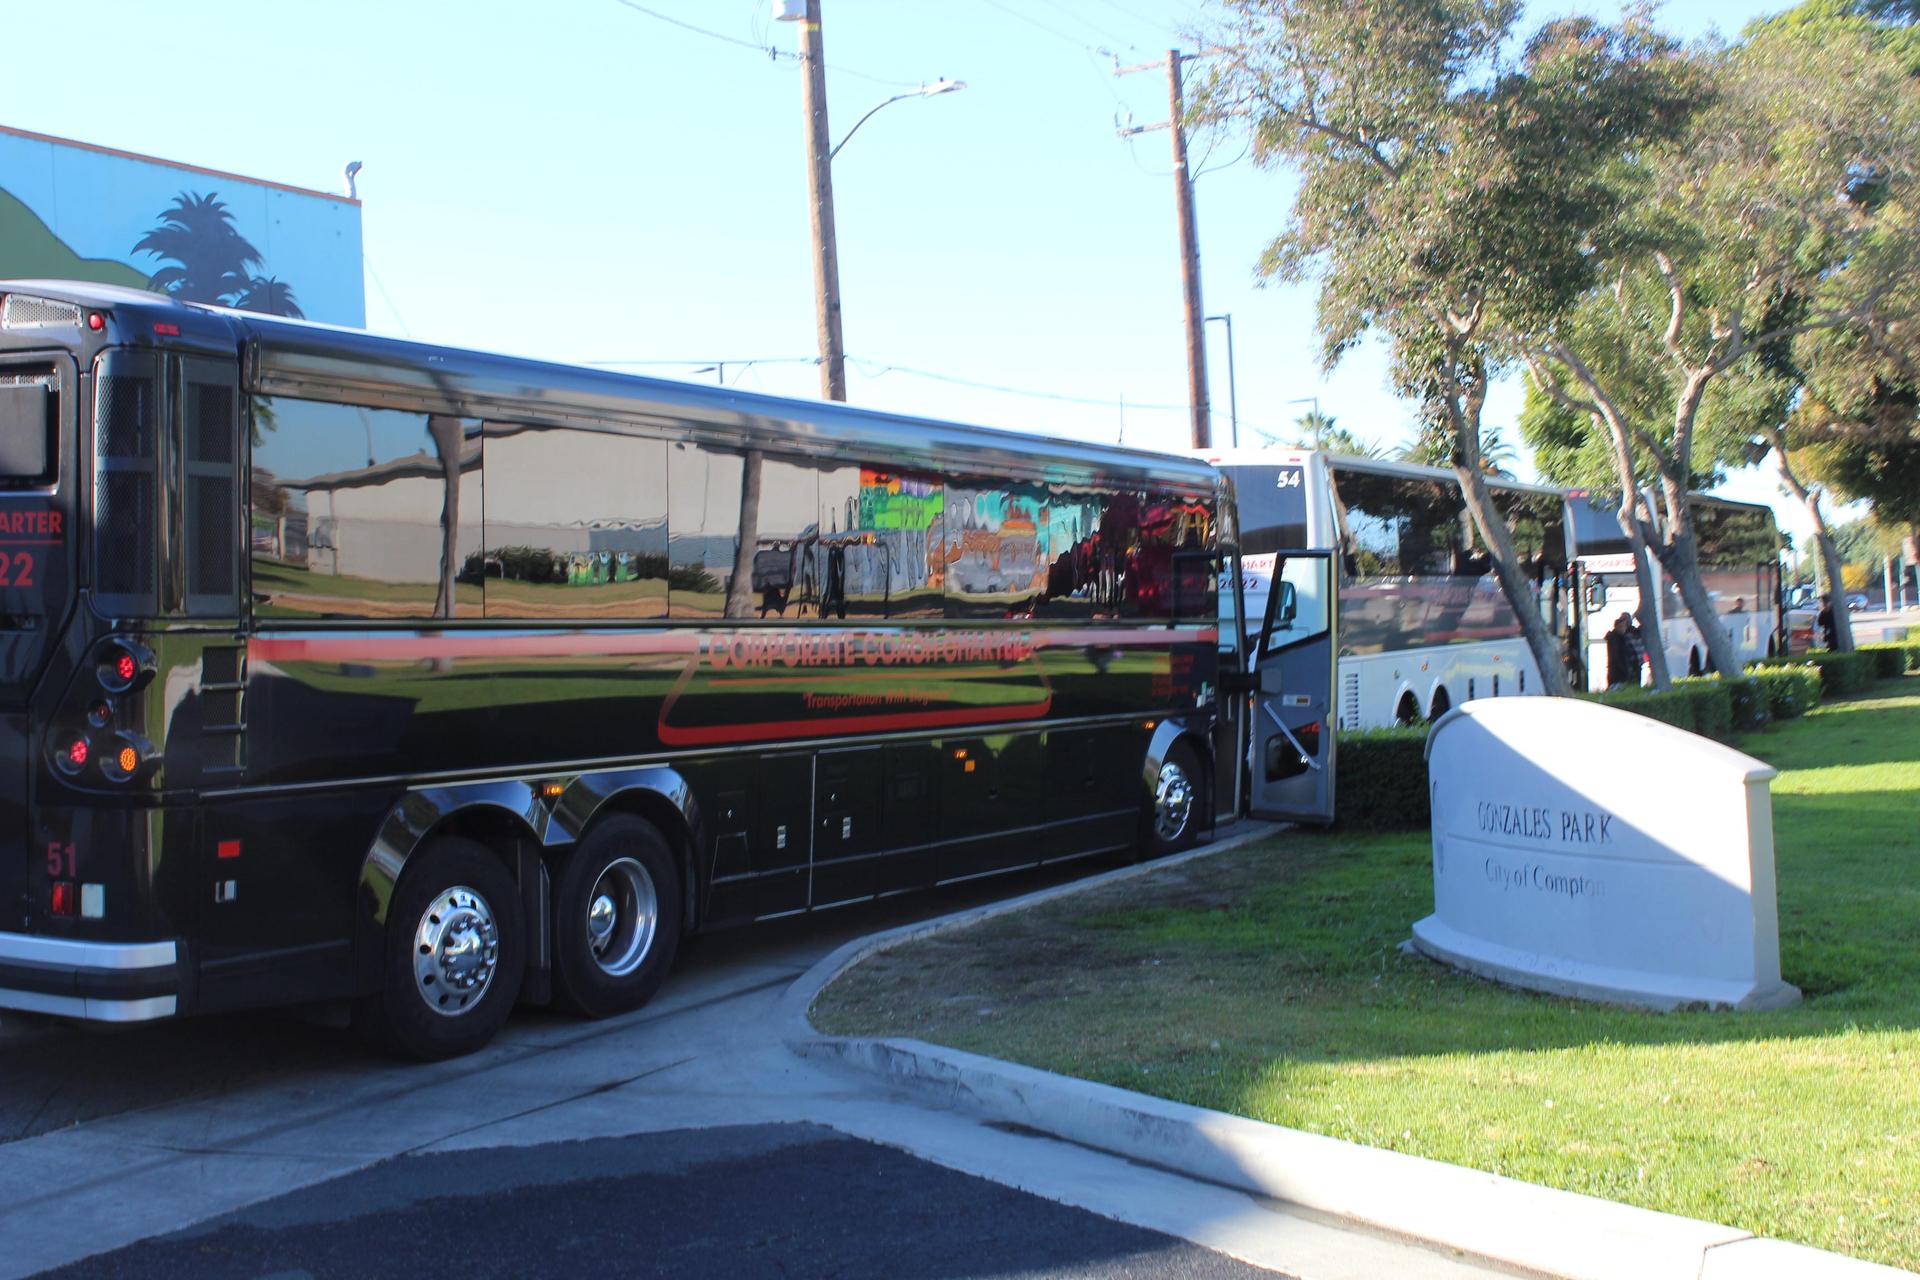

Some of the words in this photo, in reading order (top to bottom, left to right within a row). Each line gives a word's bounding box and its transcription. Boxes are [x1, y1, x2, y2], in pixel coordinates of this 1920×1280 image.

[1276, 470, 1301, 488] 54
[708, 631, 856, 670] CORPORATE
[862, 631, 938, 667] COACH
[1477, 800, 1551, 839] GONZALES
[1561, 811, 1614, 845] PARK
[47, 841, 77, 877] 51
[1485, 857, 1512, 892] City
[1513, 864, 1531, 888] of
[1532, 864, 1607, 899] Compton
